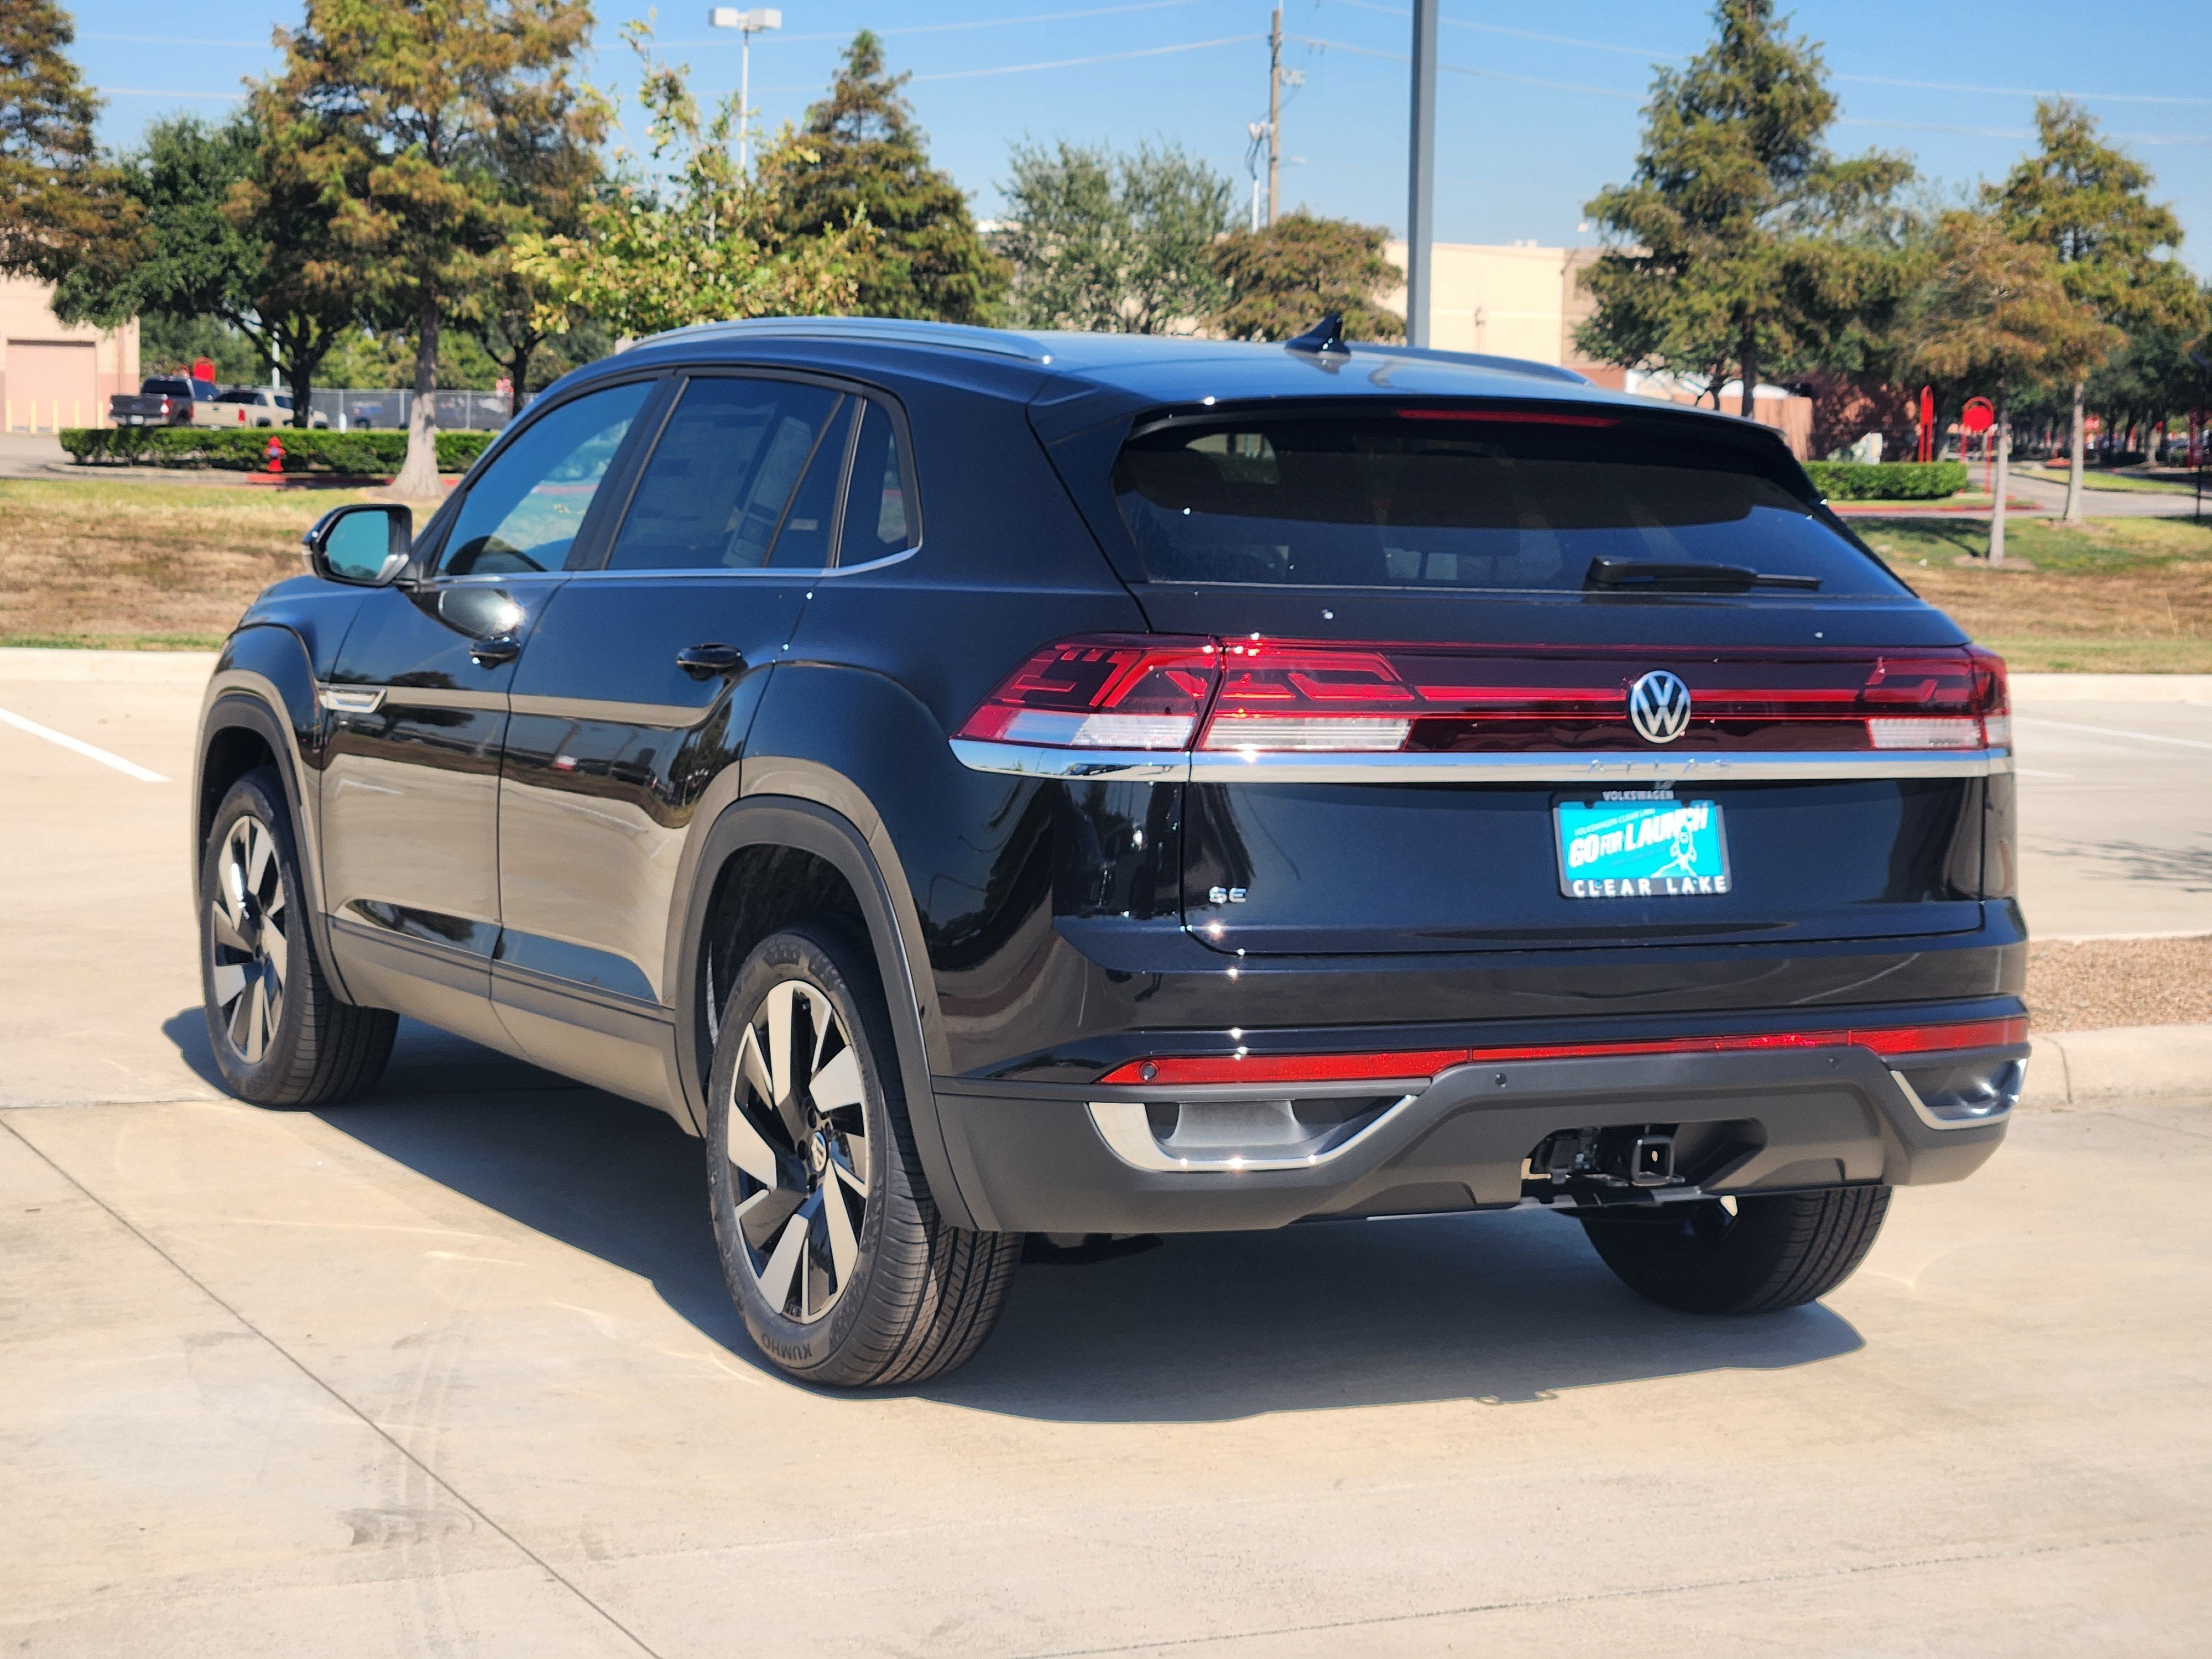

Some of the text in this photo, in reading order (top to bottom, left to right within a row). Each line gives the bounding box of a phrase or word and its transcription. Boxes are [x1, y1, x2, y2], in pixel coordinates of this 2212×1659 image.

[1630, 670, 1691, 744] VW
[1569, 834, 1599, 867] GO
[1209, 886, 1248, 904] SE
[1572, 875, 1727, 898] CLEAR LAKE
[761, 1333, 812, 1359] KUMHO
